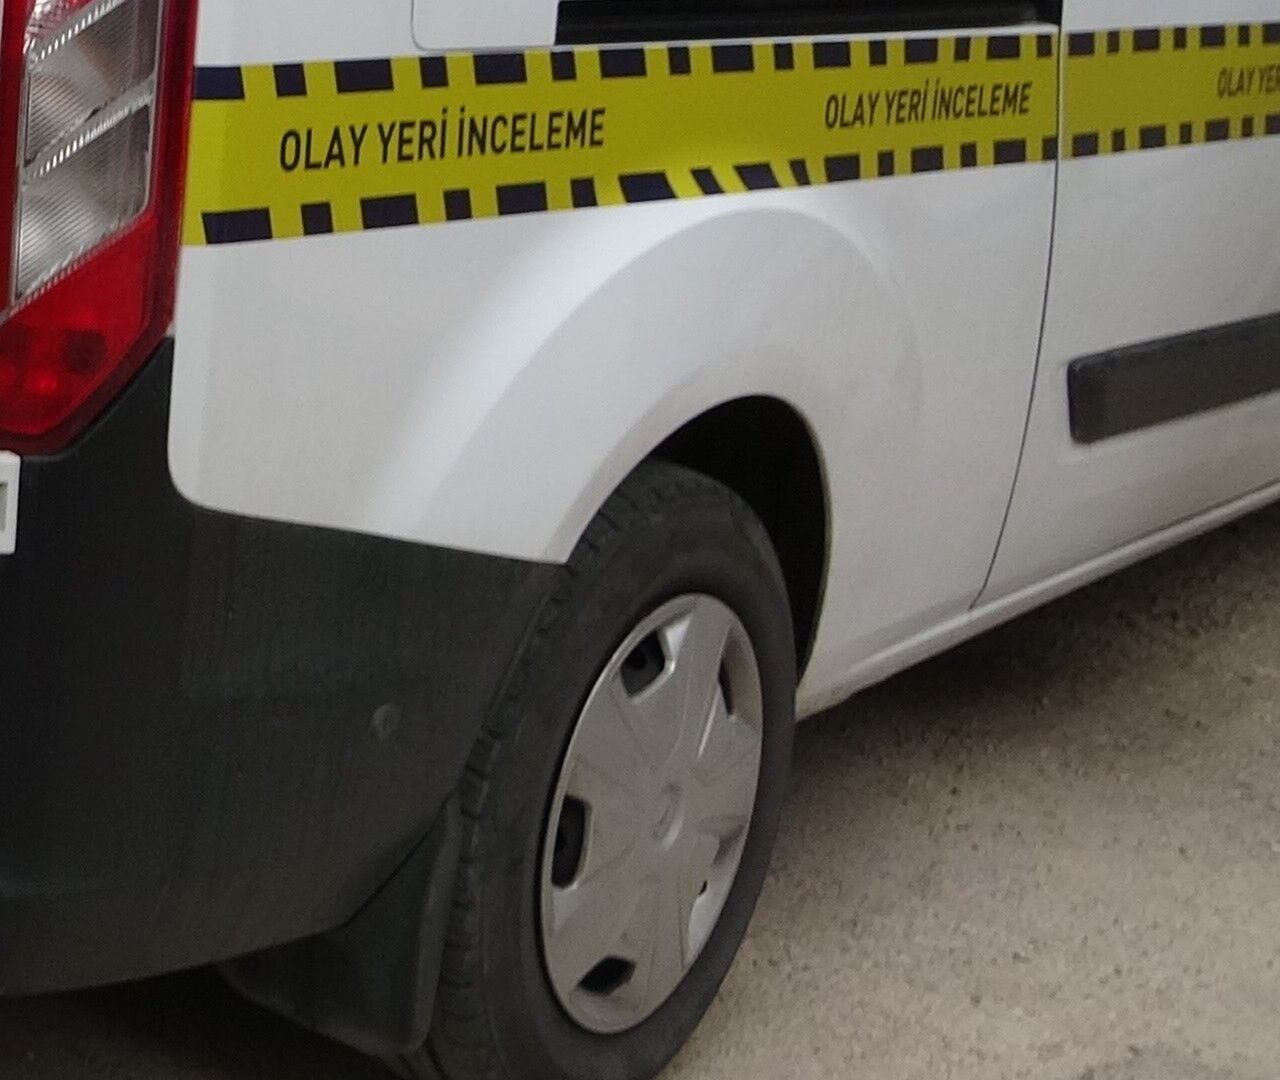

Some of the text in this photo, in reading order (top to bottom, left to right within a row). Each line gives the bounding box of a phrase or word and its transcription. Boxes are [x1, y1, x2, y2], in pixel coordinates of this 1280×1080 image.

[824, 76, 1034, 130] OLAY YERİ İNCELEME
[279, 105, 607, 173] OLAY YERİ İNCELEME
